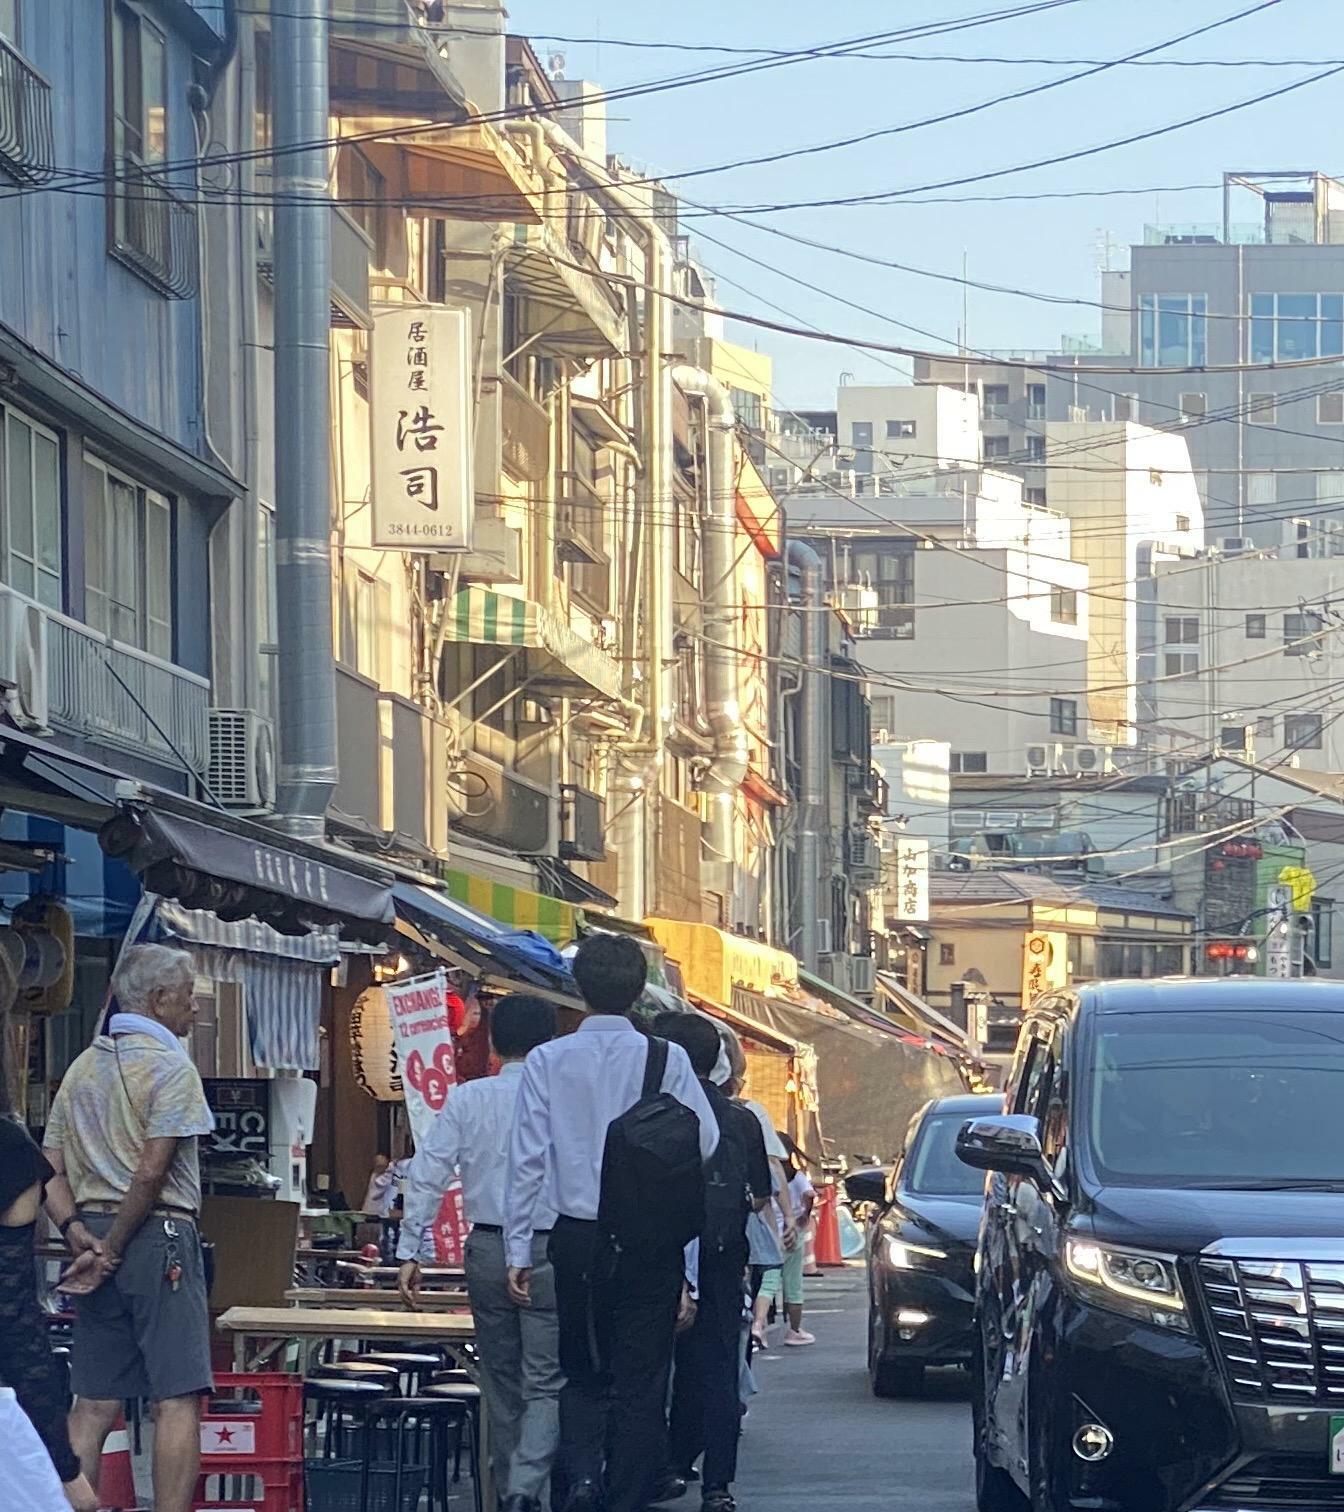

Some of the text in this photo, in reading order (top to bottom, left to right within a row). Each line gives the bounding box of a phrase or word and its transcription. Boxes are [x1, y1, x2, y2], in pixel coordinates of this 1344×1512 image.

[407, 320, 428, 391] 居酒屋
[396, 405, 445, 512] 浩司
[388, 523, 453, 537] 3844-0612
